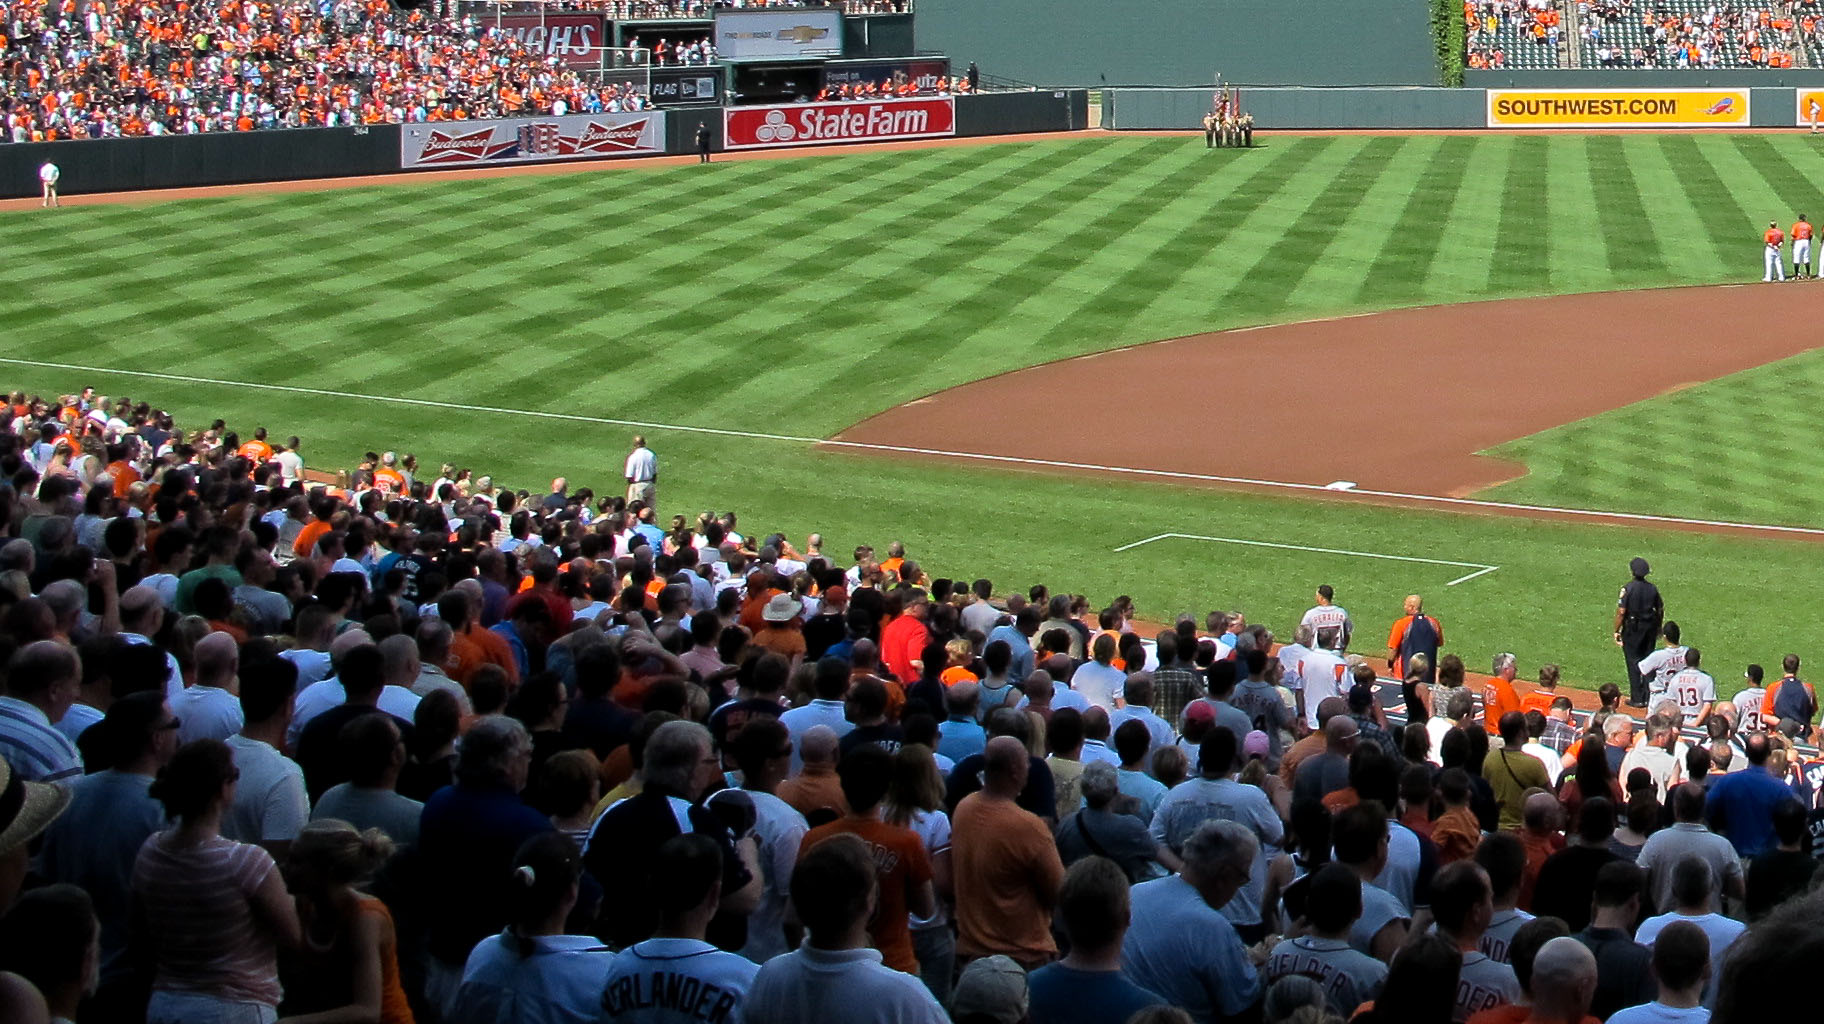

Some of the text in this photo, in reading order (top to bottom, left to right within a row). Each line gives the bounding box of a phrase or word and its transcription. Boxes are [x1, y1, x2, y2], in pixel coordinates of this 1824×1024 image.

[653, 83, 677, 95] FLAG
[1497, 98, 1676, 117] SOUTHWEST.COM
[1678, 687, 1699, 707] 13
[601, 971, 736, 1023] VERLANDER
